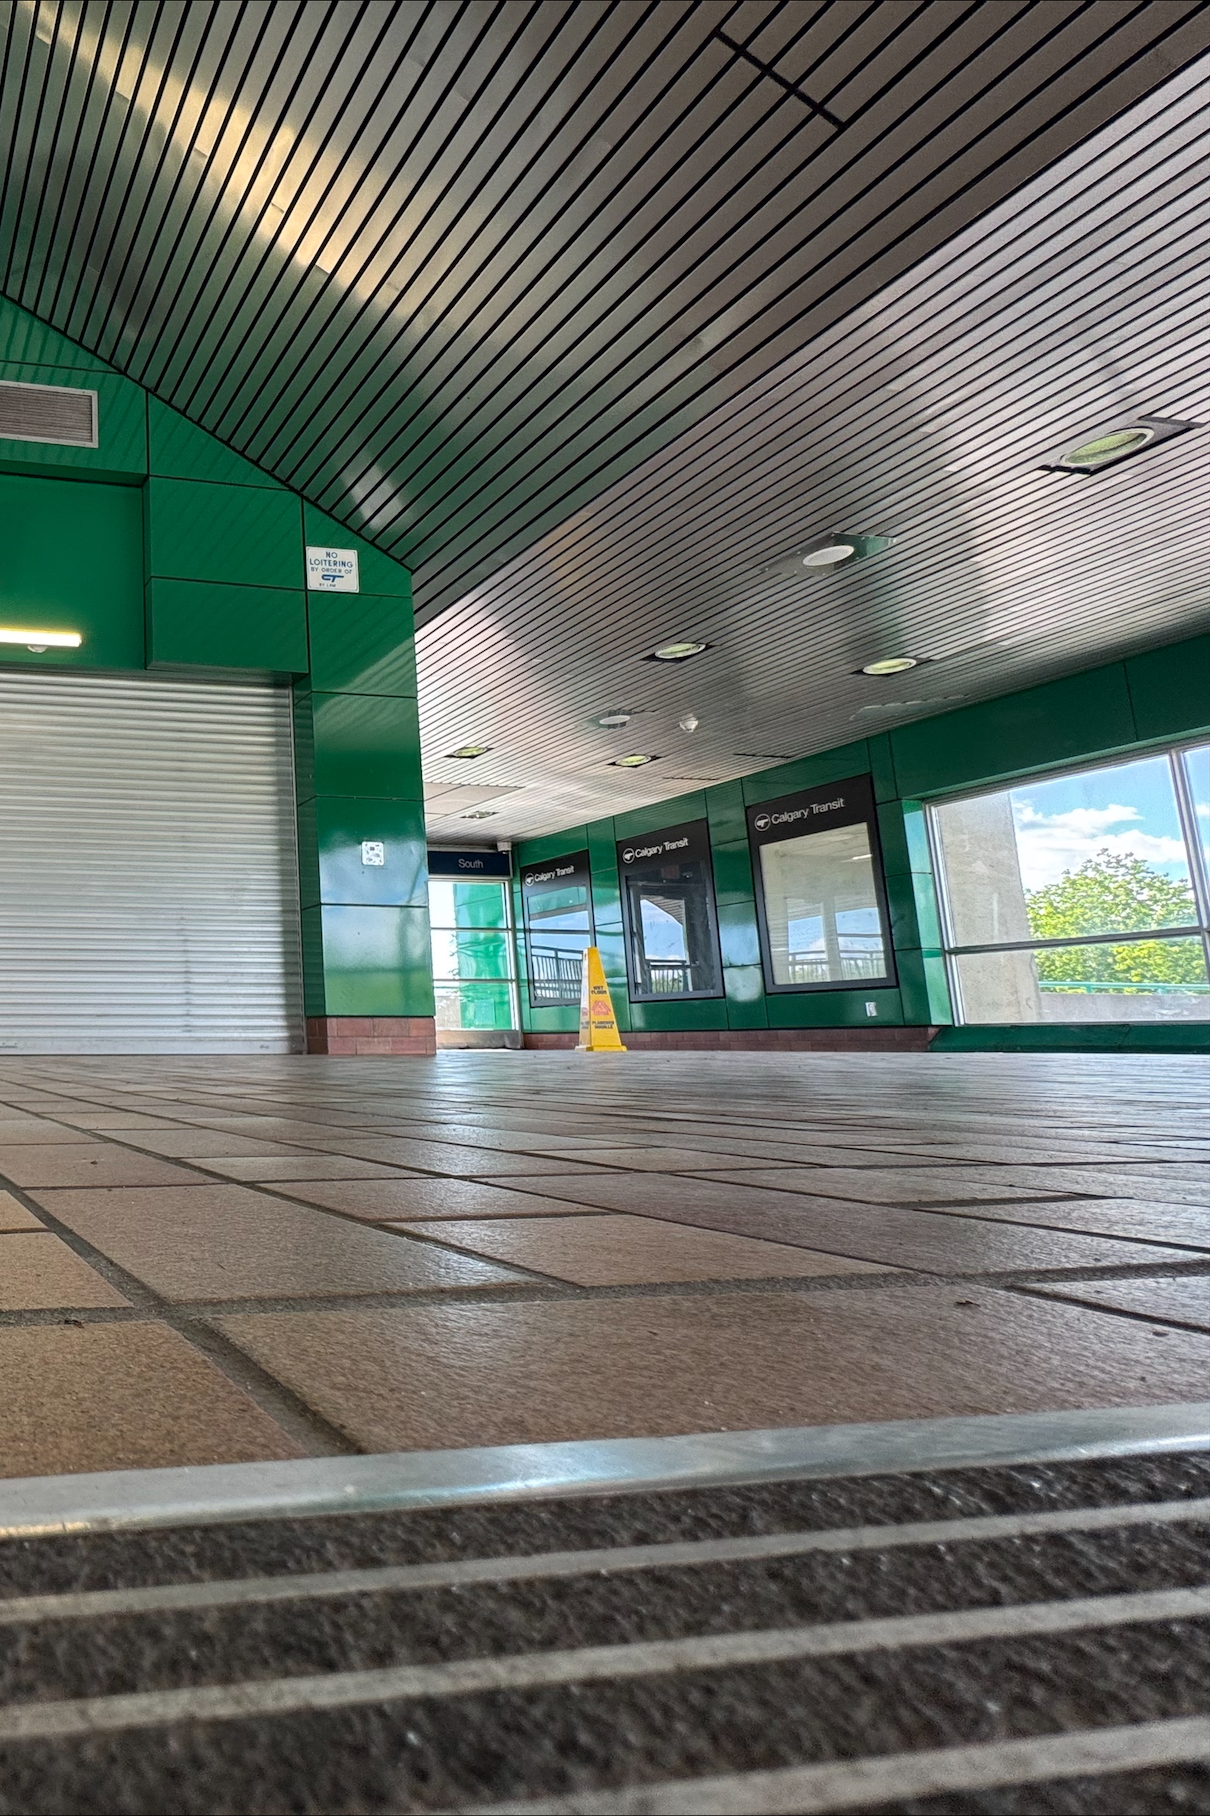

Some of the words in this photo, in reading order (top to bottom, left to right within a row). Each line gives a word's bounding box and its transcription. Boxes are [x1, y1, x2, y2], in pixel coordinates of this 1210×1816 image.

[325, 551, 338, 559] NO
[309, 558, 354, 569] LOITERING
[771, 808, 810, 825] Calgary
[810, 797, 845, 815] Transit
[635, 843, 663, 858] Calgary
[663, 837, 689, 851] Transit
[458, 858, 484, 869] South
[534, 872, 556, 882] Calgary
[555, 864, 575, 877] Transit
